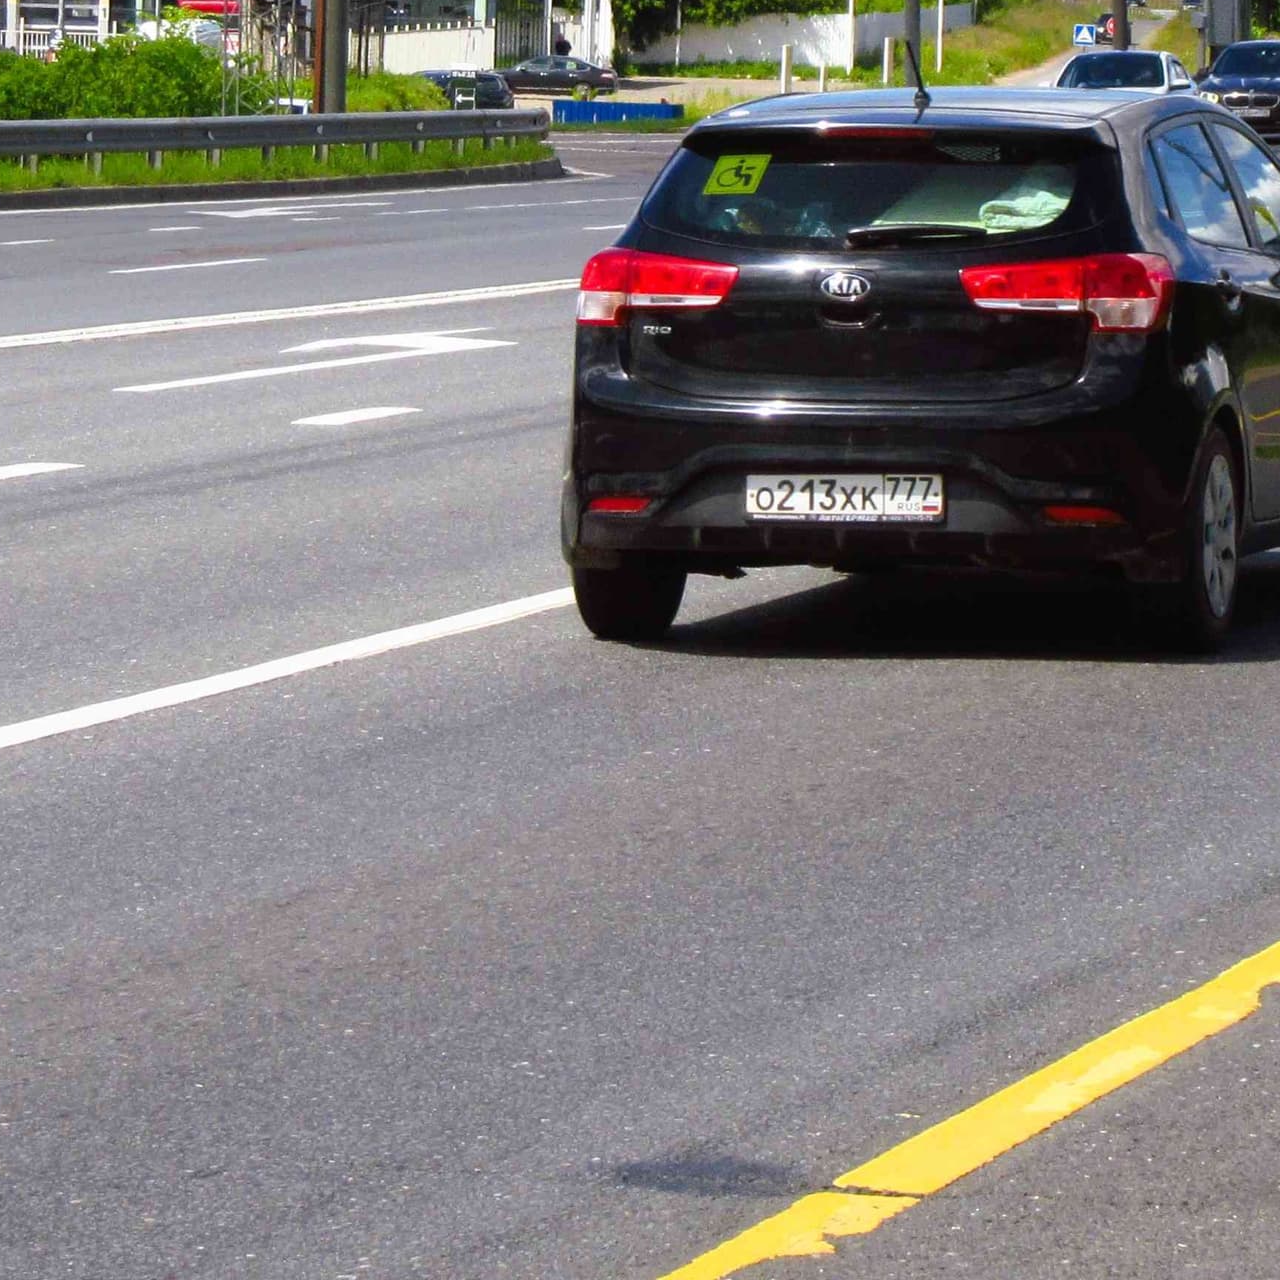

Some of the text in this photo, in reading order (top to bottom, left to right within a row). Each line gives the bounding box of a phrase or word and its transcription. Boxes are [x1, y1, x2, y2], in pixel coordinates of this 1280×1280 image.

[827, 276, 862, 294] KIA
[755, 477, 934, 511] О213ХК 777
[897, 502, 921, 511] RUS
